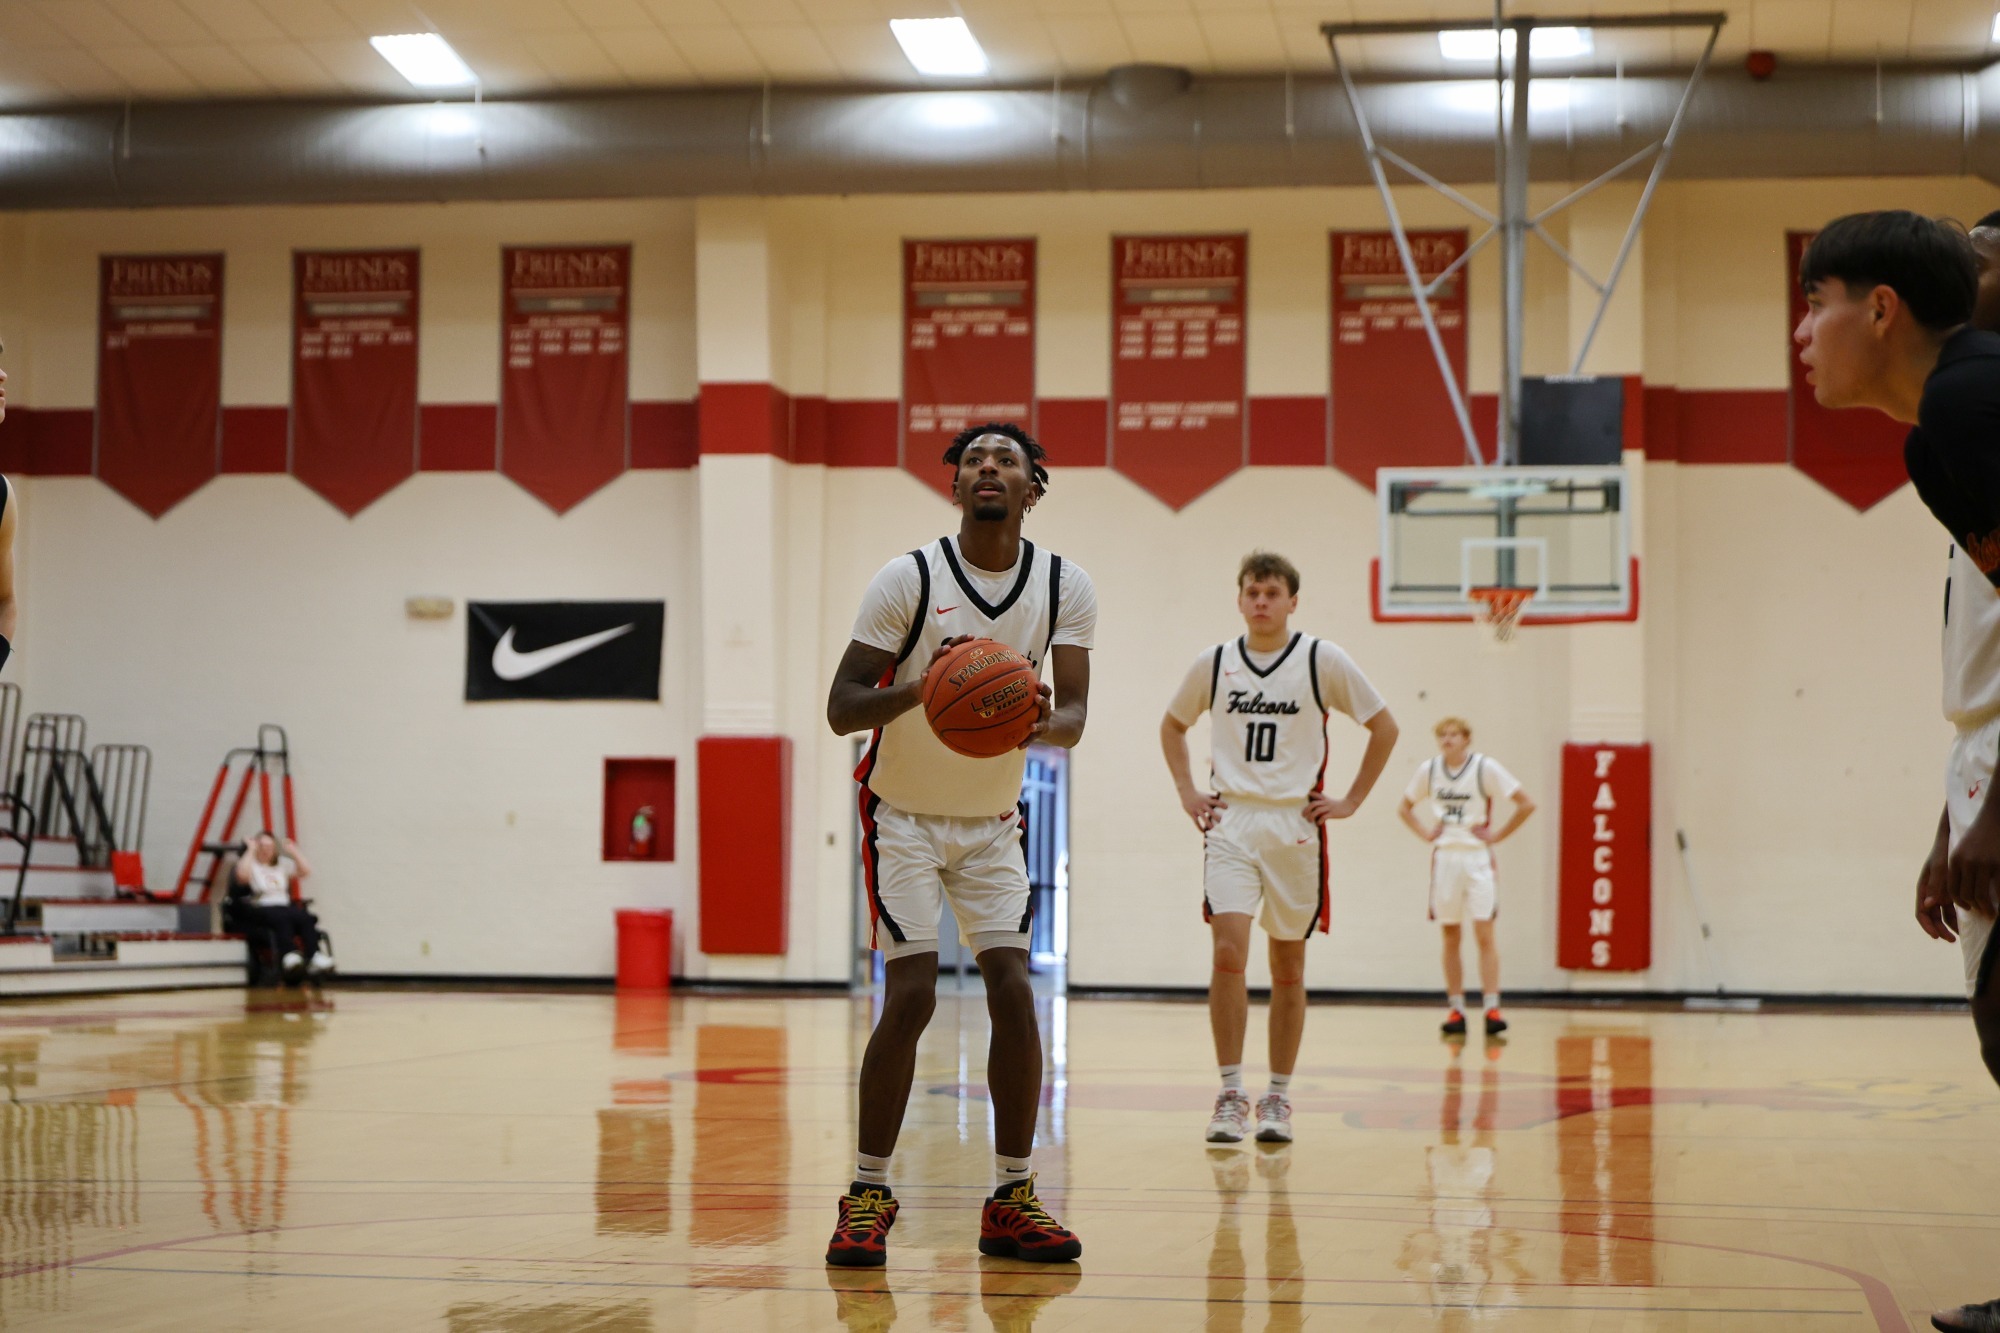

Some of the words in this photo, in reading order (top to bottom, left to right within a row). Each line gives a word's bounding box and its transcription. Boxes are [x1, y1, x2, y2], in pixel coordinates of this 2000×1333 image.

[916, 243, 1024, 267] FRIENDS
[1125, 239, 1235, 263] FRIENDS
[970, 676, 1028, 713] LEGACY
[1226, 690, 1300, 715] Falcons
[1245, 721, 1277, 762] 10
[1589, 751, 1616, 967] FALCONS
